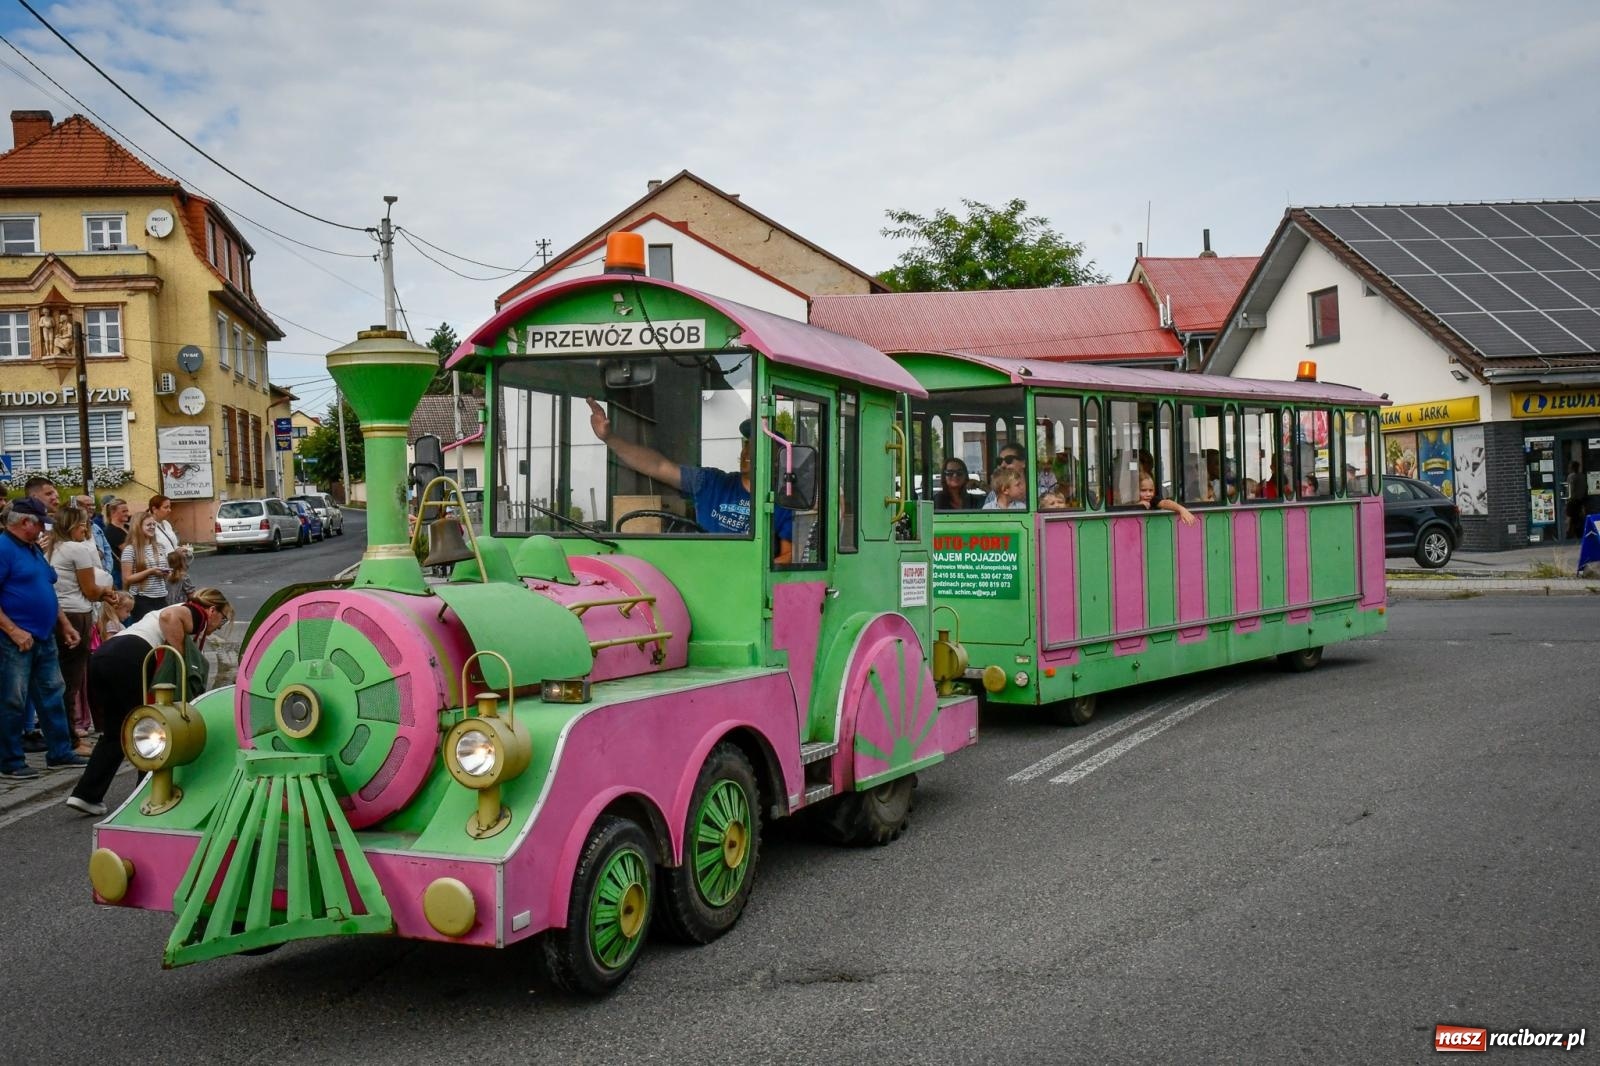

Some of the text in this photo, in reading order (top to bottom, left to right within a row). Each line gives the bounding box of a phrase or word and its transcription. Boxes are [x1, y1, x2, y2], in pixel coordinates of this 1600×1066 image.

[531, 322, 701, 348] PRZEWÓZ OSÓB
[0, 387, 131, 406] TUDIO FYZUR
[1551, 394, 1600, 409] LEWIA
[1380, 410, 1402, 425] ATAN
[1419, 405, 1449, 421] JARKA
[933, 535, 1010, 551] UTO-PORT
[933, 551, 1017, 562] NAJEM POJAZDÓW
